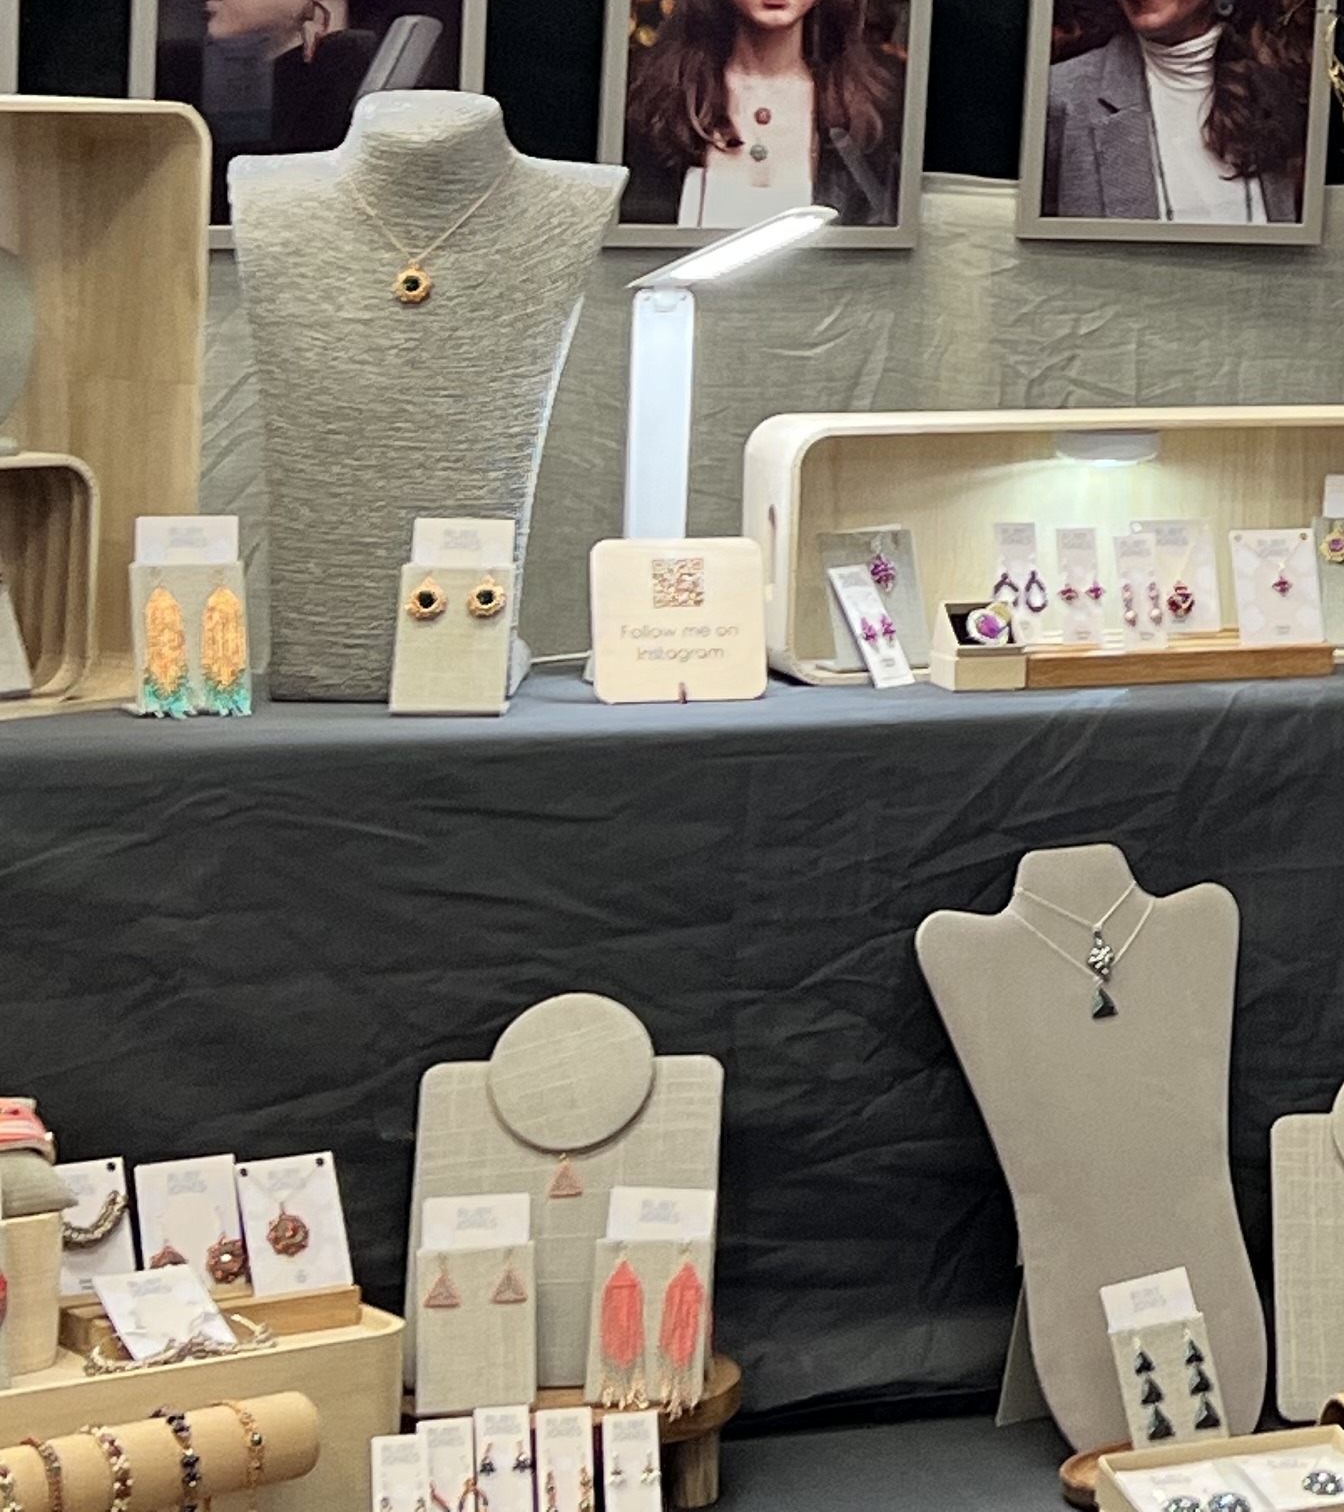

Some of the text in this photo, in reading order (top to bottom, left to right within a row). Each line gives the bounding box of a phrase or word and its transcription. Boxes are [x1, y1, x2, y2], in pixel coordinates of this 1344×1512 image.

[620, 624, 739, 639] Follow me on
